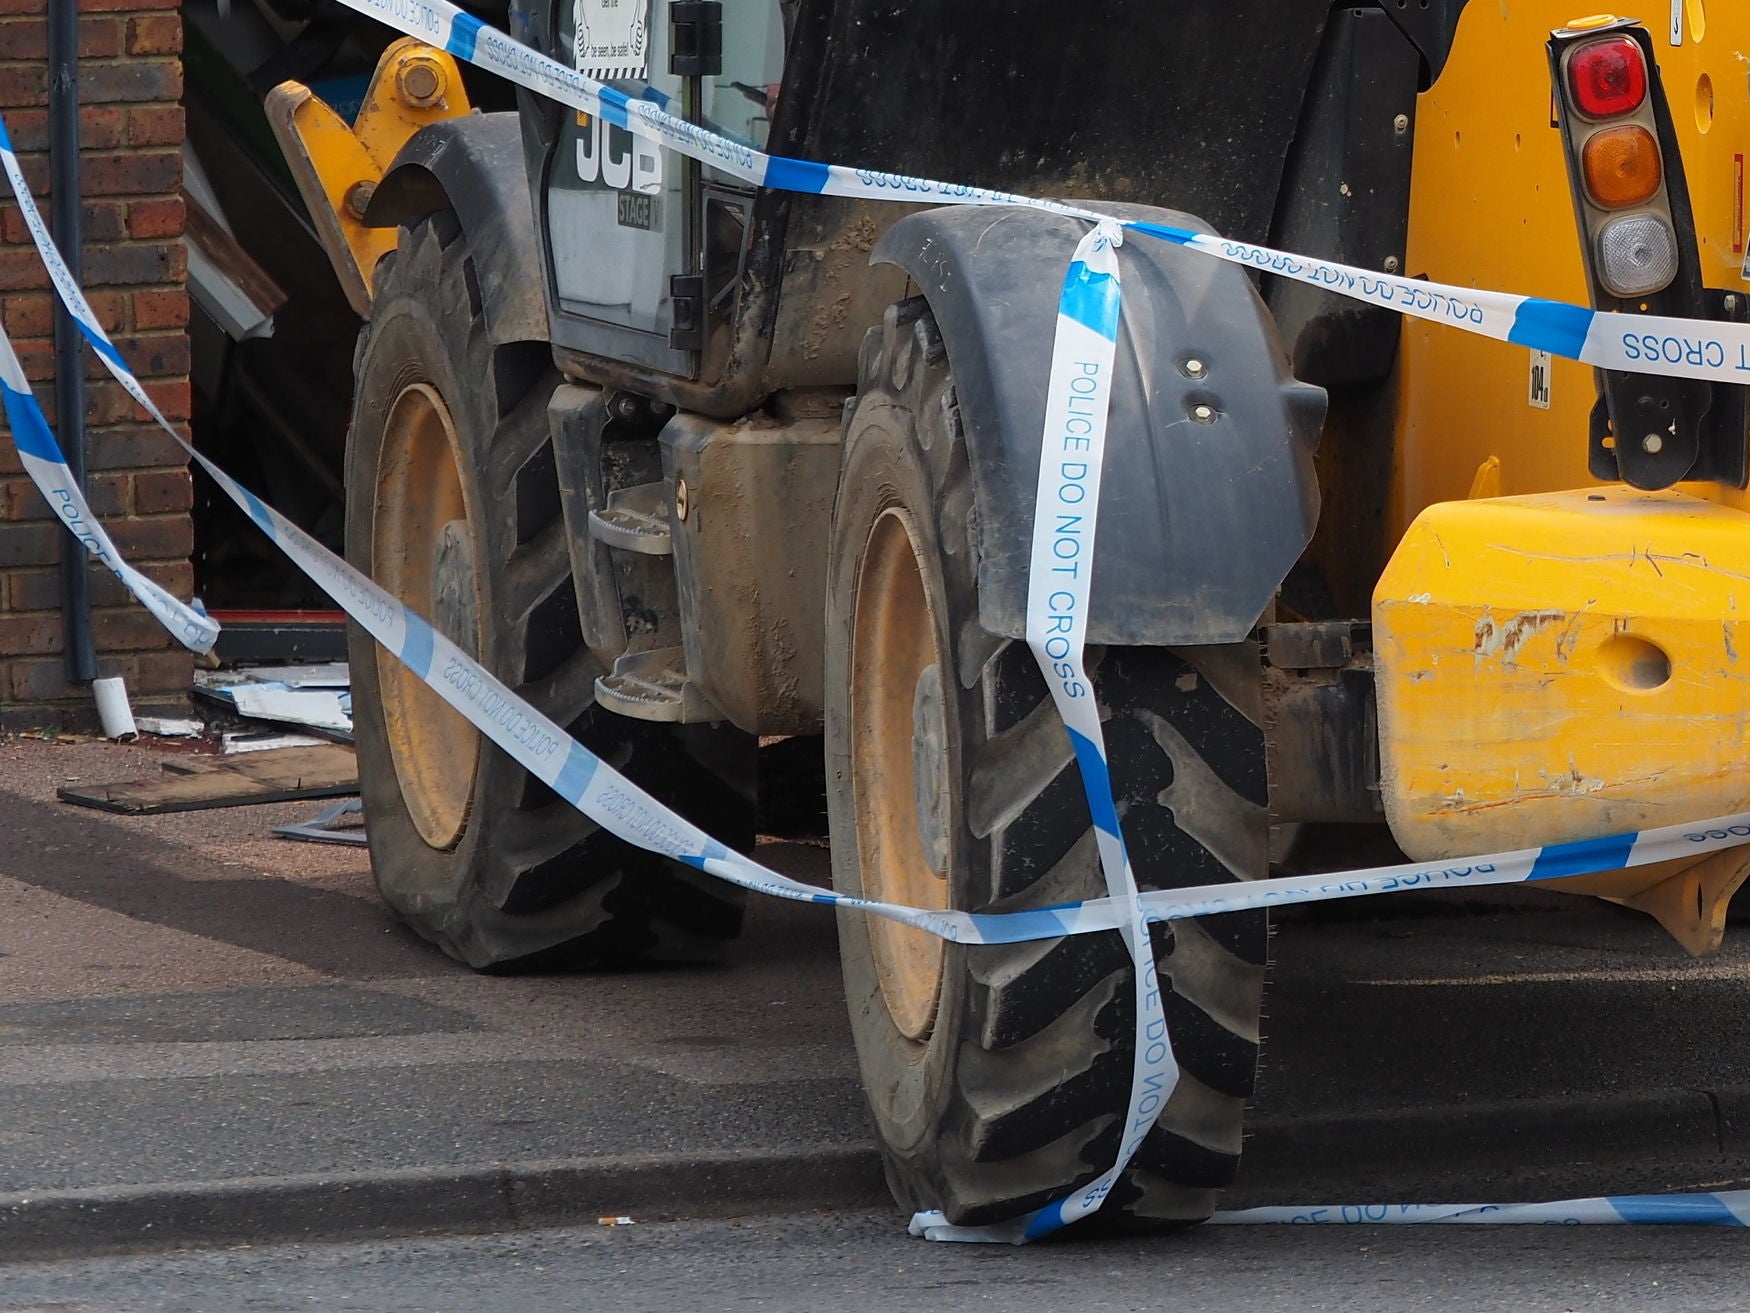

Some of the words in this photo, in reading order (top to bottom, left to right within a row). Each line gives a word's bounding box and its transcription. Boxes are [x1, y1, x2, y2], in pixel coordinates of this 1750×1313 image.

[407, 0, 440, 34] POLICE
[591, 43, 597, 57] be
[611, 43, 617, 57] be
[577, 113, 662, 194] JCB
[619, 195, 649, 227] STAGE
[1220, 241, 1302, 275] CROSS
[1359, 276, 1396, 301] DO
[1400, 285, 1484, 325] POLICE
[1622, 333, 1724, 369] CROSS
[1062, 360, 1099, 452] POLICE
[1057, 462, 1088, 504] DO
[1051, 514, 1081, 580] NOT
[1044, 590, 1086, 699] CROSS
